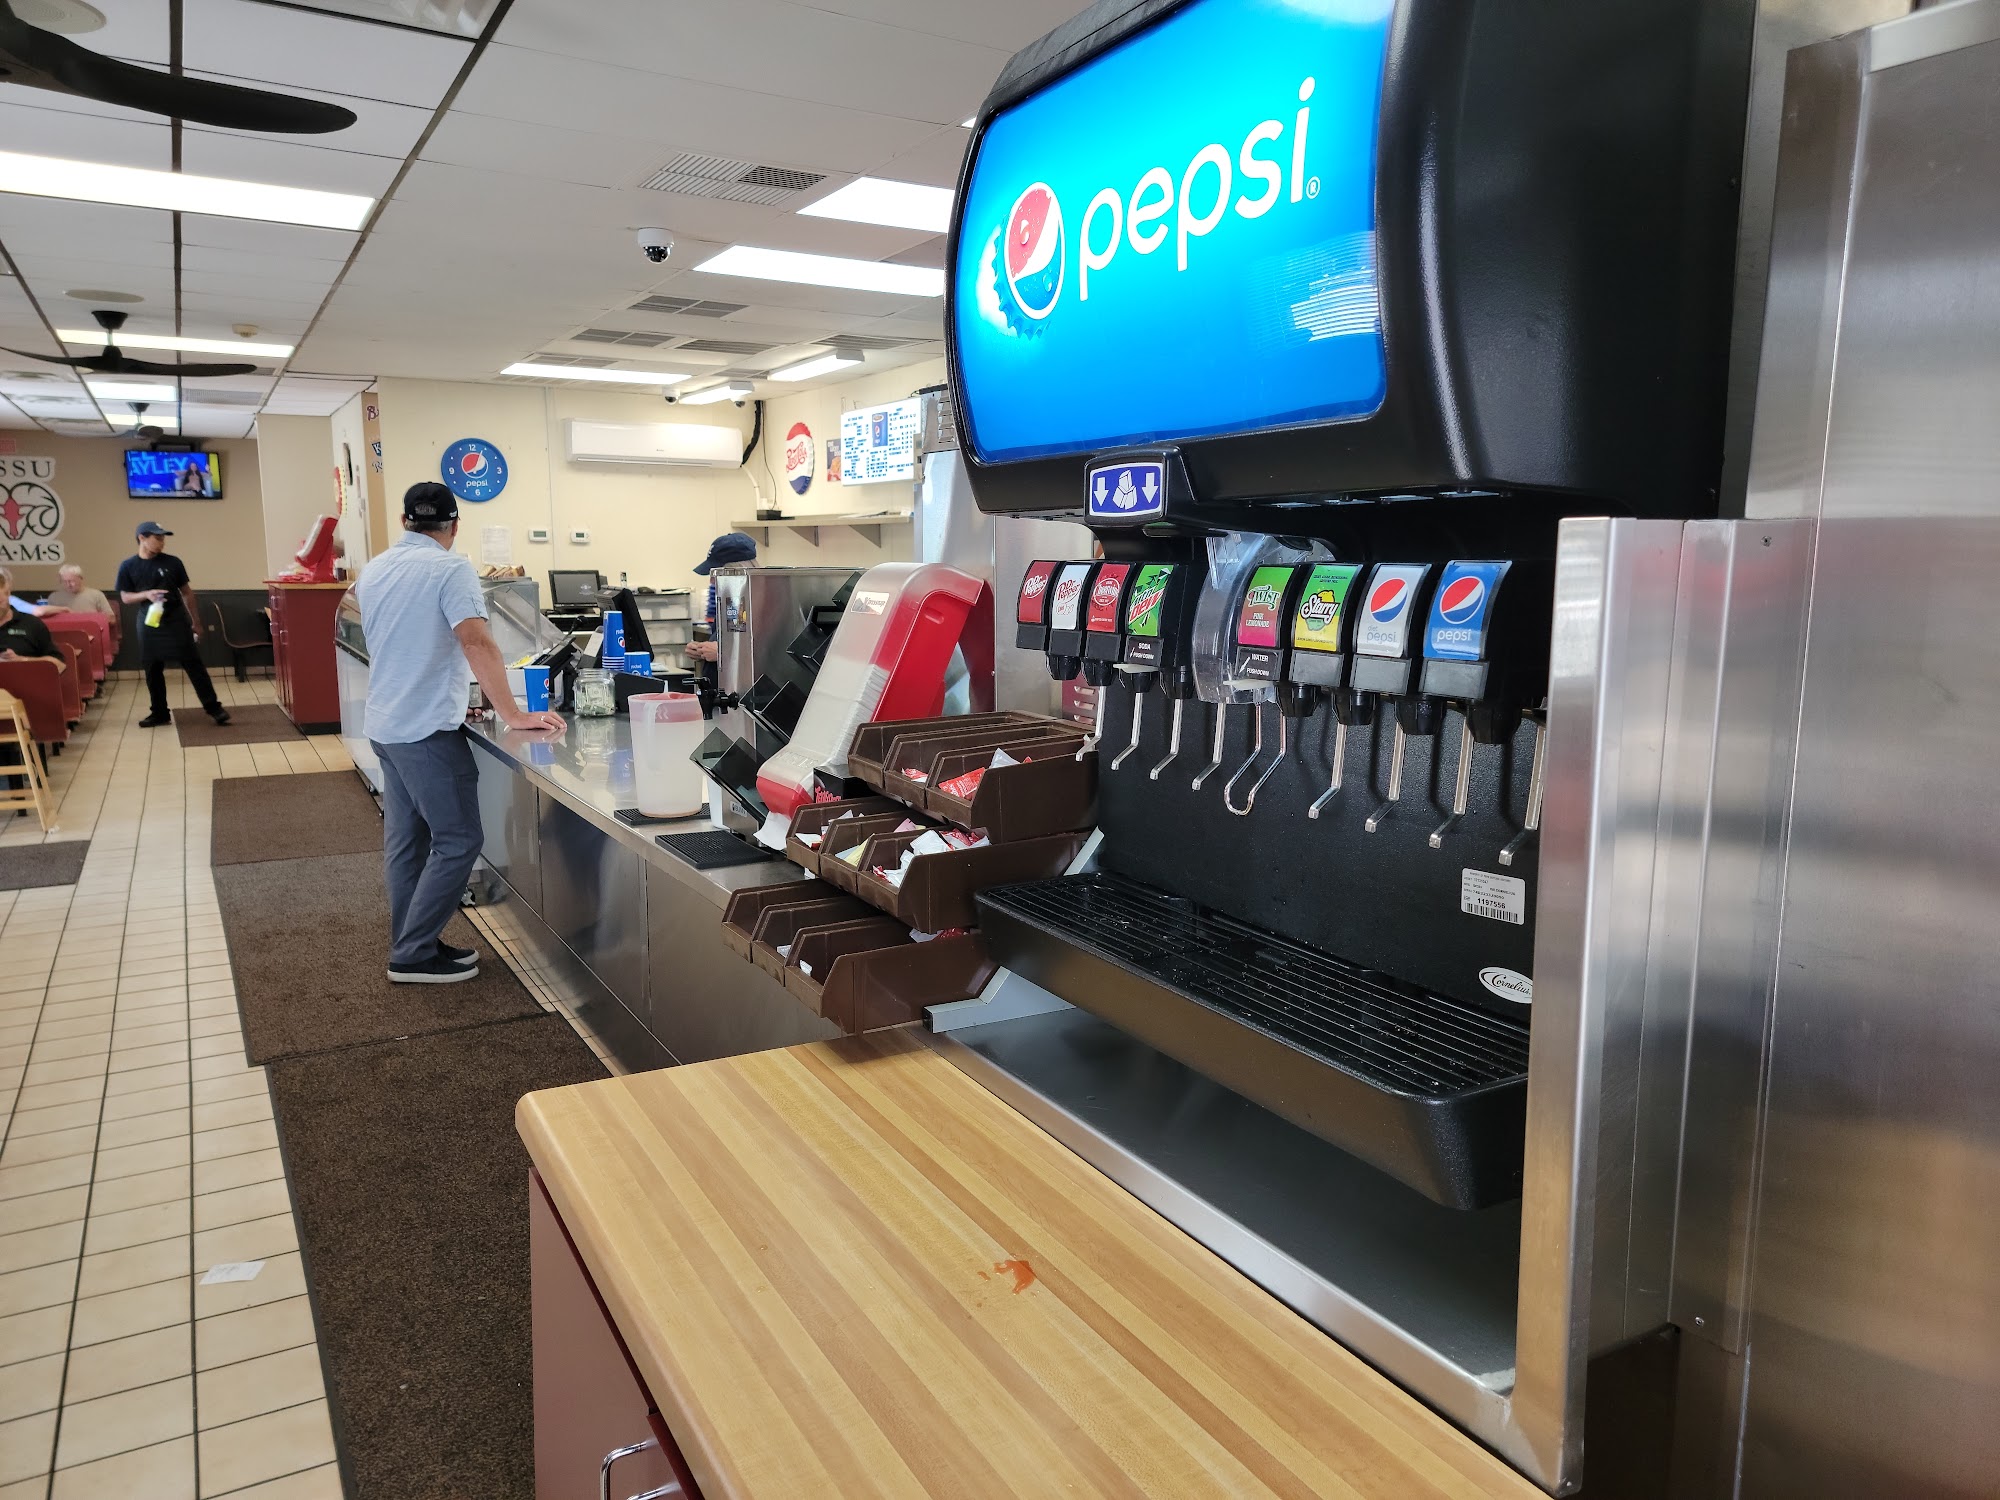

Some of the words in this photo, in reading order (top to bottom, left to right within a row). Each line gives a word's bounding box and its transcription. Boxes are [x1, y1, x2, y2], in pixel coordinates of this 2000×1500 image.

[1080, 76, 1316, 301] pepsi
[448, 467, 455, 475] 9
[466, 479, 488, 488] pepsi
[1301, 594, 1339, 624] Starry
[1366, 631, 1397, 644] pepsi
[1436, 629, 1472, 643] pepsi
[1251, 653, 1269, 662] WATER
